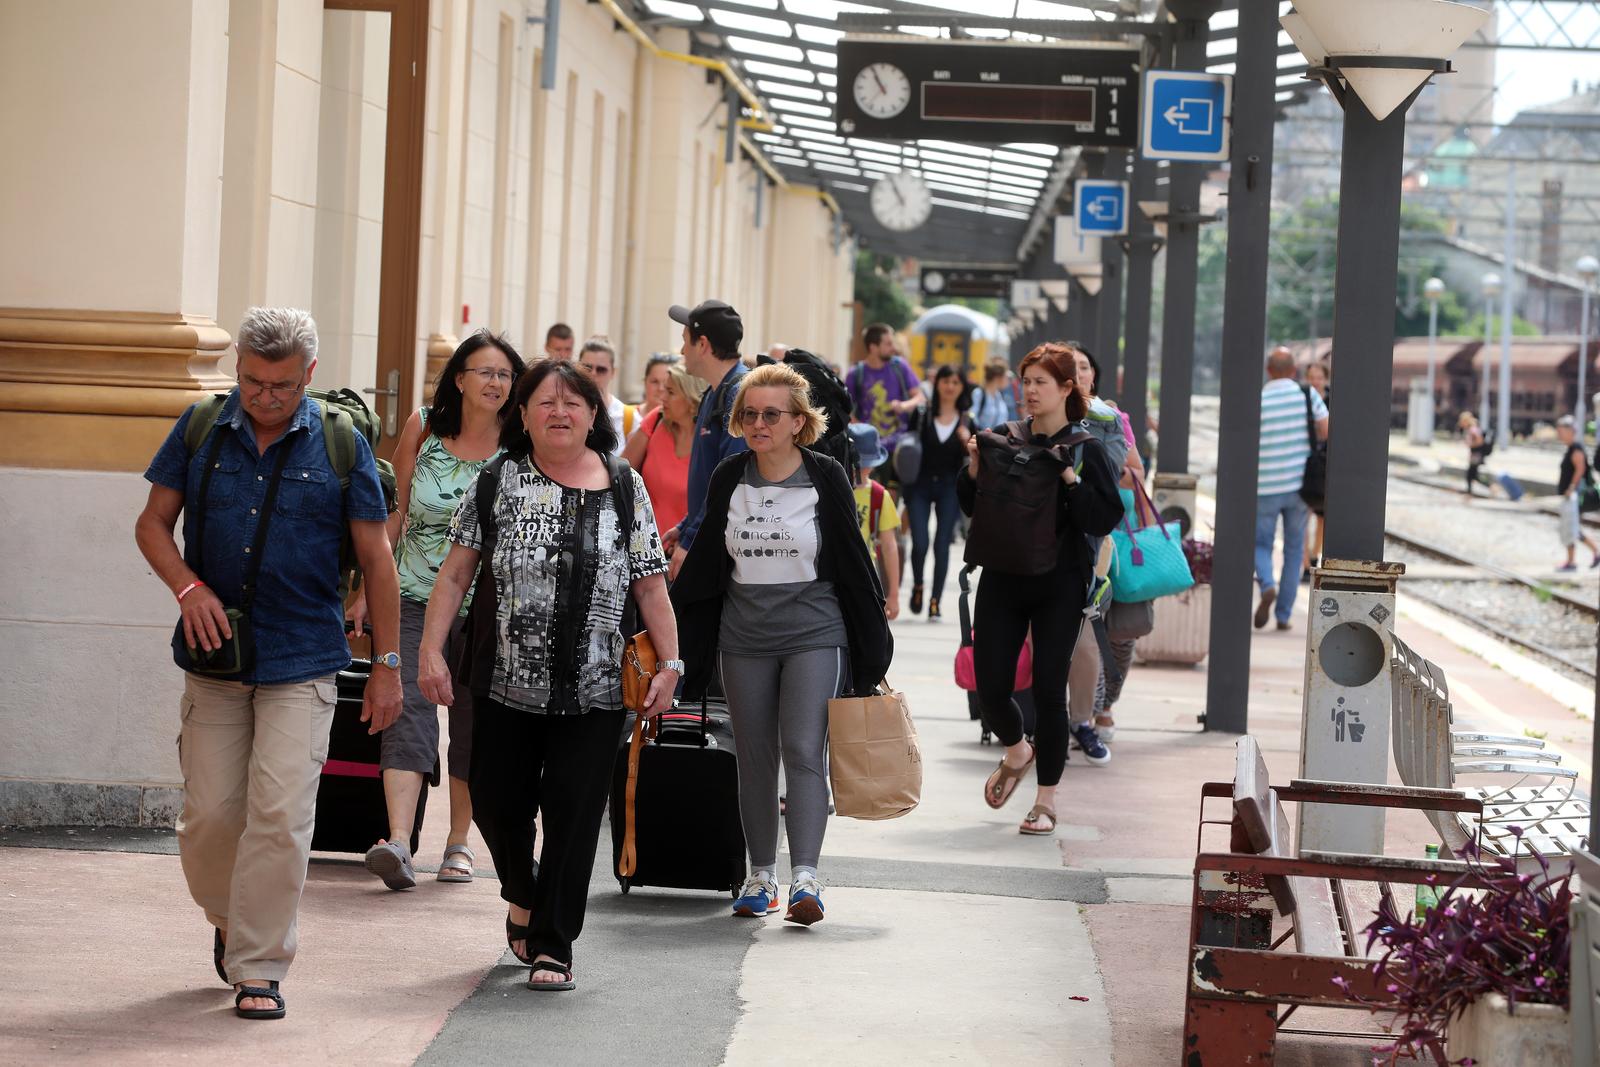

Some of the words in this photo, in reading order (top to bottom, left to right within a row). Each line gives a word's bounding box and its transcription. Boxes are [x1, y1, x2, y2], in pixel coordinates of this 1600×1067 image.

[1109, 88, 1118, 105] 1
[1108, 108, 1117, 125] 1
[758, 496, 774, 508] Je
[732, 527, 795, 542] français,
[731, 546, 799, 558] Madame
